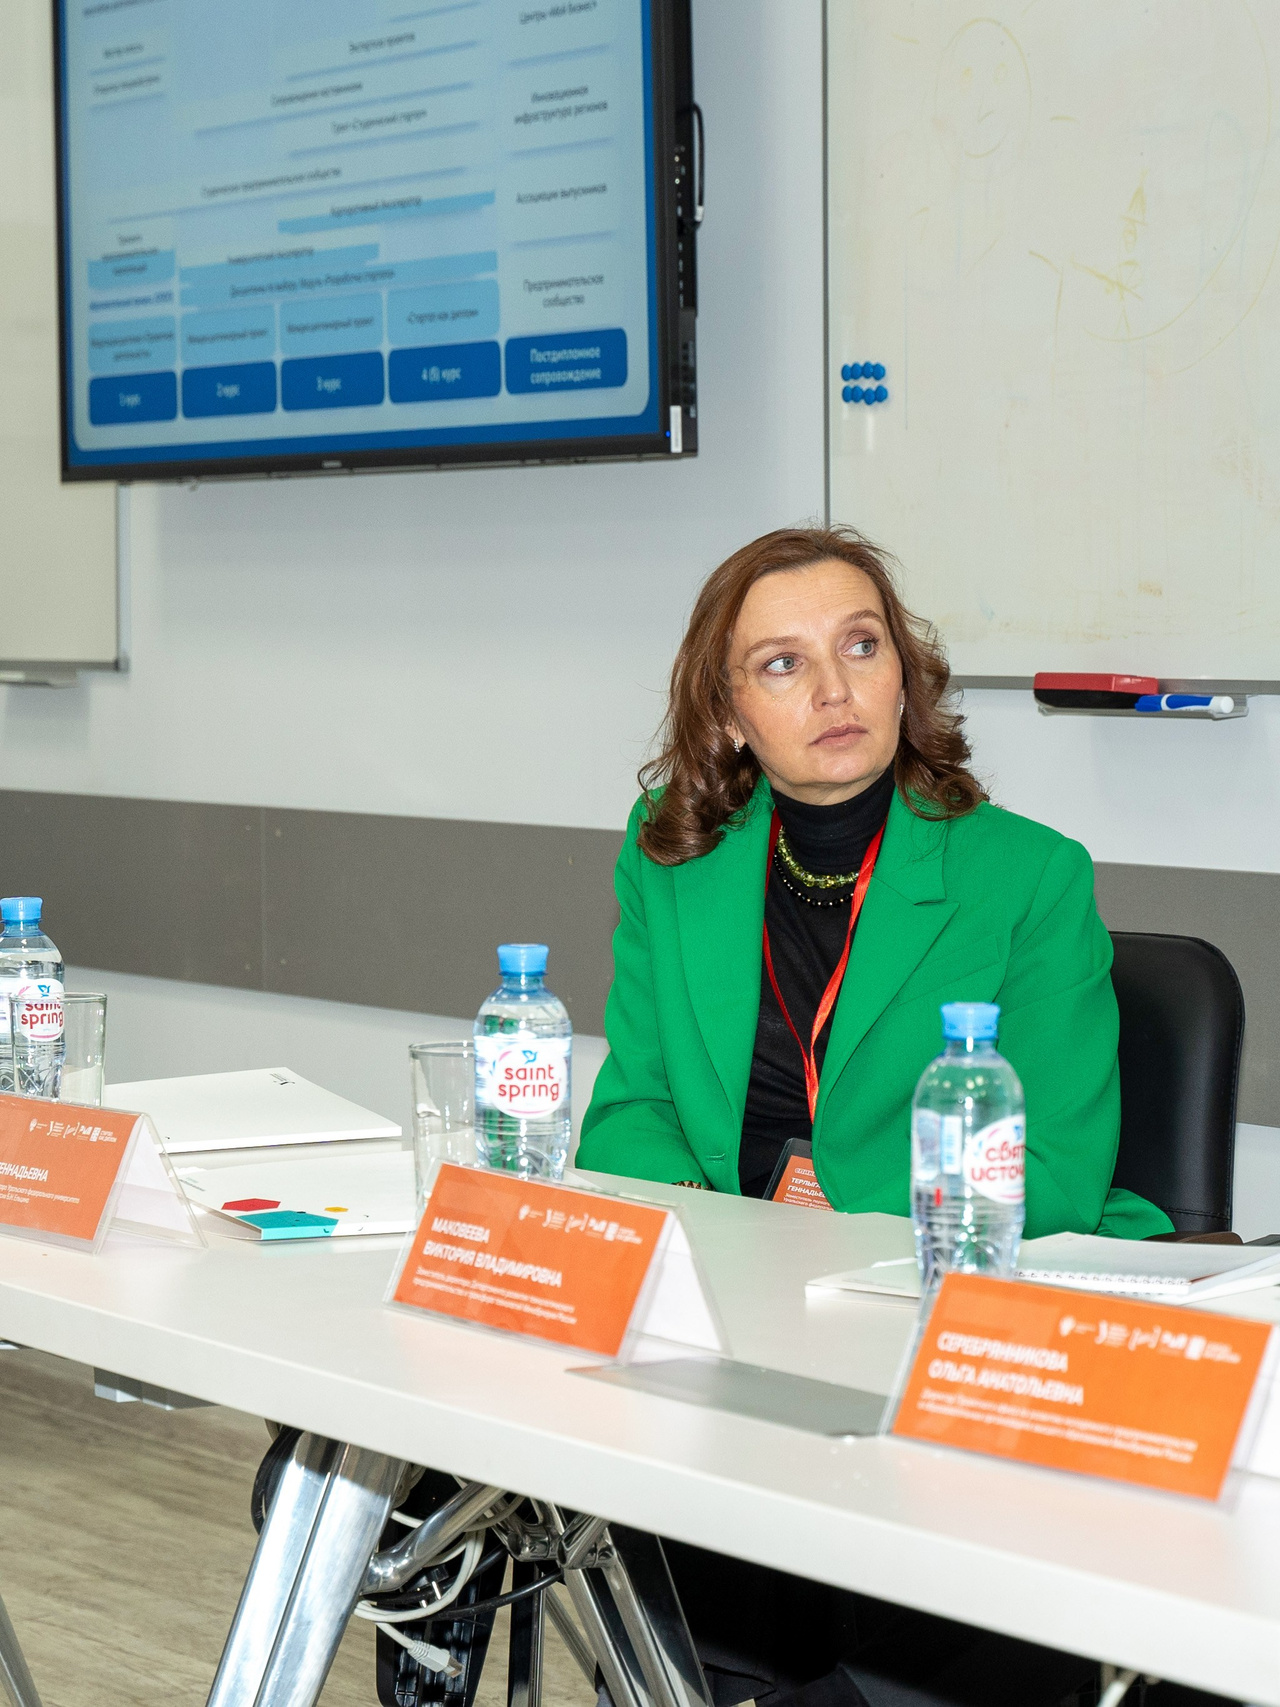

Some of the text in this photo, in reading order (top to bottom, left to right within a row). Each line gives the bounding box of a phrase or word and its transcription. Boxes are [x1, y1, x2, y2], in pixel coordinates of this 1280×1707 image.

[529, 347, 601, 364] Постдипломное
[529, 368, 602, 387] сопровождение
[21, 1011, 64, 1030] spring
[505, 1064, 554, 1081] saint
[498, 1082, 559, 1103] spring
[0, 1161, 48, 1182] ЕННАДЬЕВНА
[431, 1216, 491, 1244] МАКОВЕЕВА
[422, 1240, 474, 1265] ВИКТОРИЯ
[474, 1250, 563, 1288] ВЛАДИМИРОВНА
[937, 1330, 1068, 1373] СЕРЕБРЯННИКОВА
[928, 1358, 977, 1384] ОЛЬГА
[977, 1366, 1085, 1406] АНАТОЛЬЕВНА
